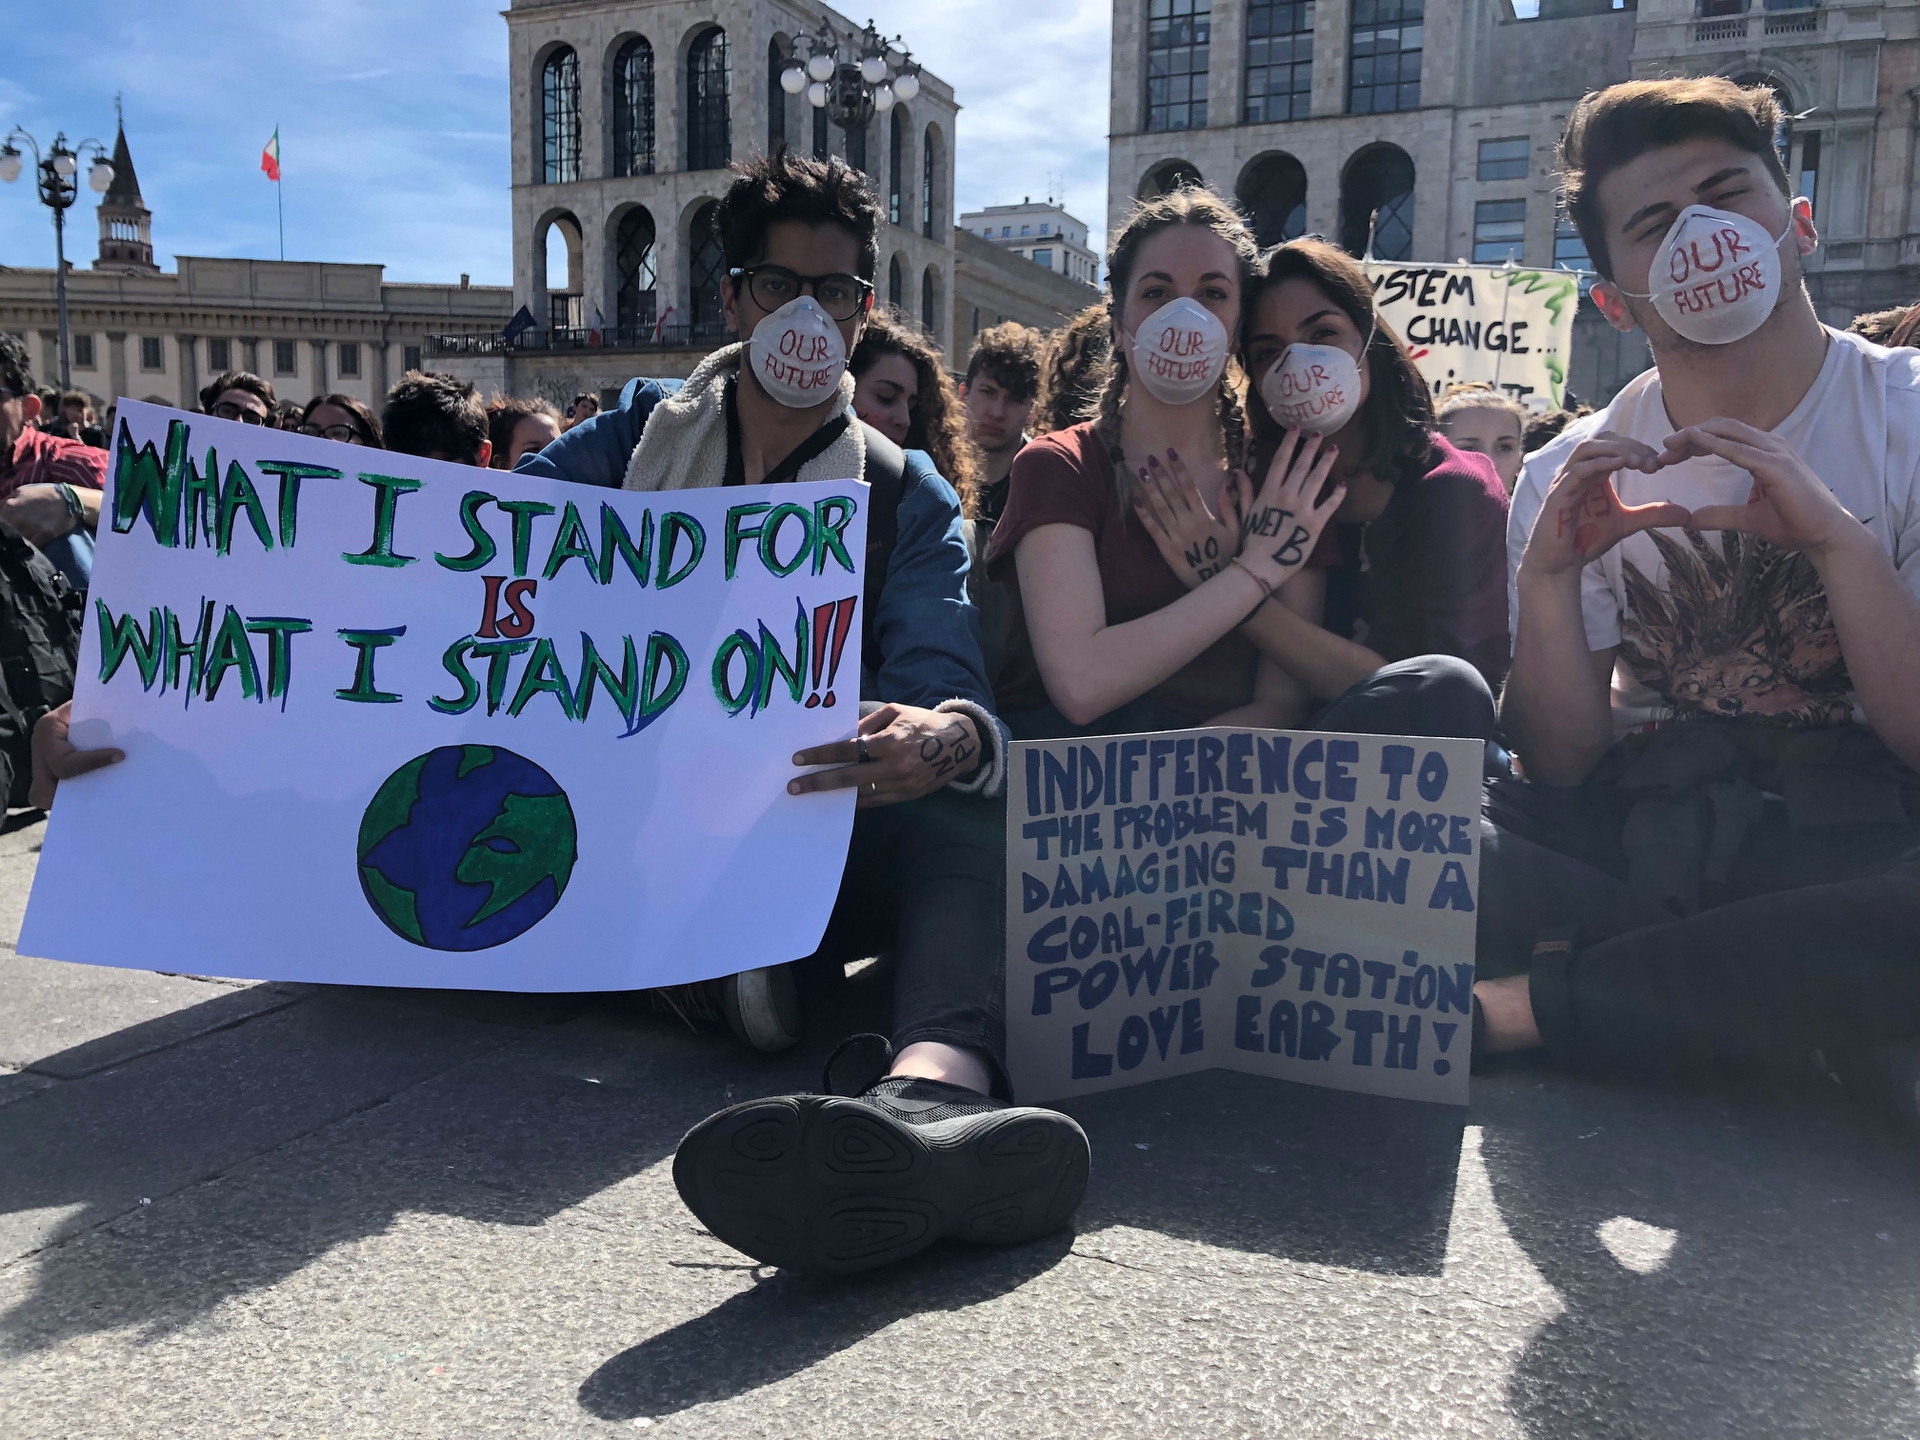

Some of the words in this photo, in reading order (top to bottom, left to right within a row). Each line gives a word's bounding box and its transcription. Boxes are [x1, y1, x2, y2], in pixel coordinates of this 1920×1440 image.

[1670, 229, 1750, 284] OUR
[1673, 261, 1766, 315] FUTURE
[779, 329, 829, 362] OUR
[1148, 352, 1211, 381] FUTURE
[1159, 327, 1204, 357] OUR
[765, 353, 832, 390] FUTURE
[1280, 364, 1329, 398] OUR
[112, 417, 344, 556] WHAT
[340, 472, 427, 567] I
[434, 490, 706, 589] STAND
[724, 495, 857, 582] FOR
[1184, 536, 1218, 568] NO
[1271, 525, 1310, 566] B
[475, 576, 538, 638] IS
[96, 596, 312, 713] WHAT
[333, 626, 407, 703] I
[428, 630, 690, 739] STAND
[712, 595, 858, 719] ON!!
[1025, 733, 1360, 816] INDIFFERENCE
[1380, 744, 1449, 802] TO
[1022, 812, 1103, 860] THE
[1113, 796, 1268, 849] PROBLEM
[1364, 806, 1472, 855] MORE
[1261, 846, 1410, 904] THAN
[1428, 860, 1475, 911] A
[1031, 940, 1220, 1015] POWER
[1071, 998, 1204, 1080] LOVE
[1235, 995, 1458, 1076] EARTH!
